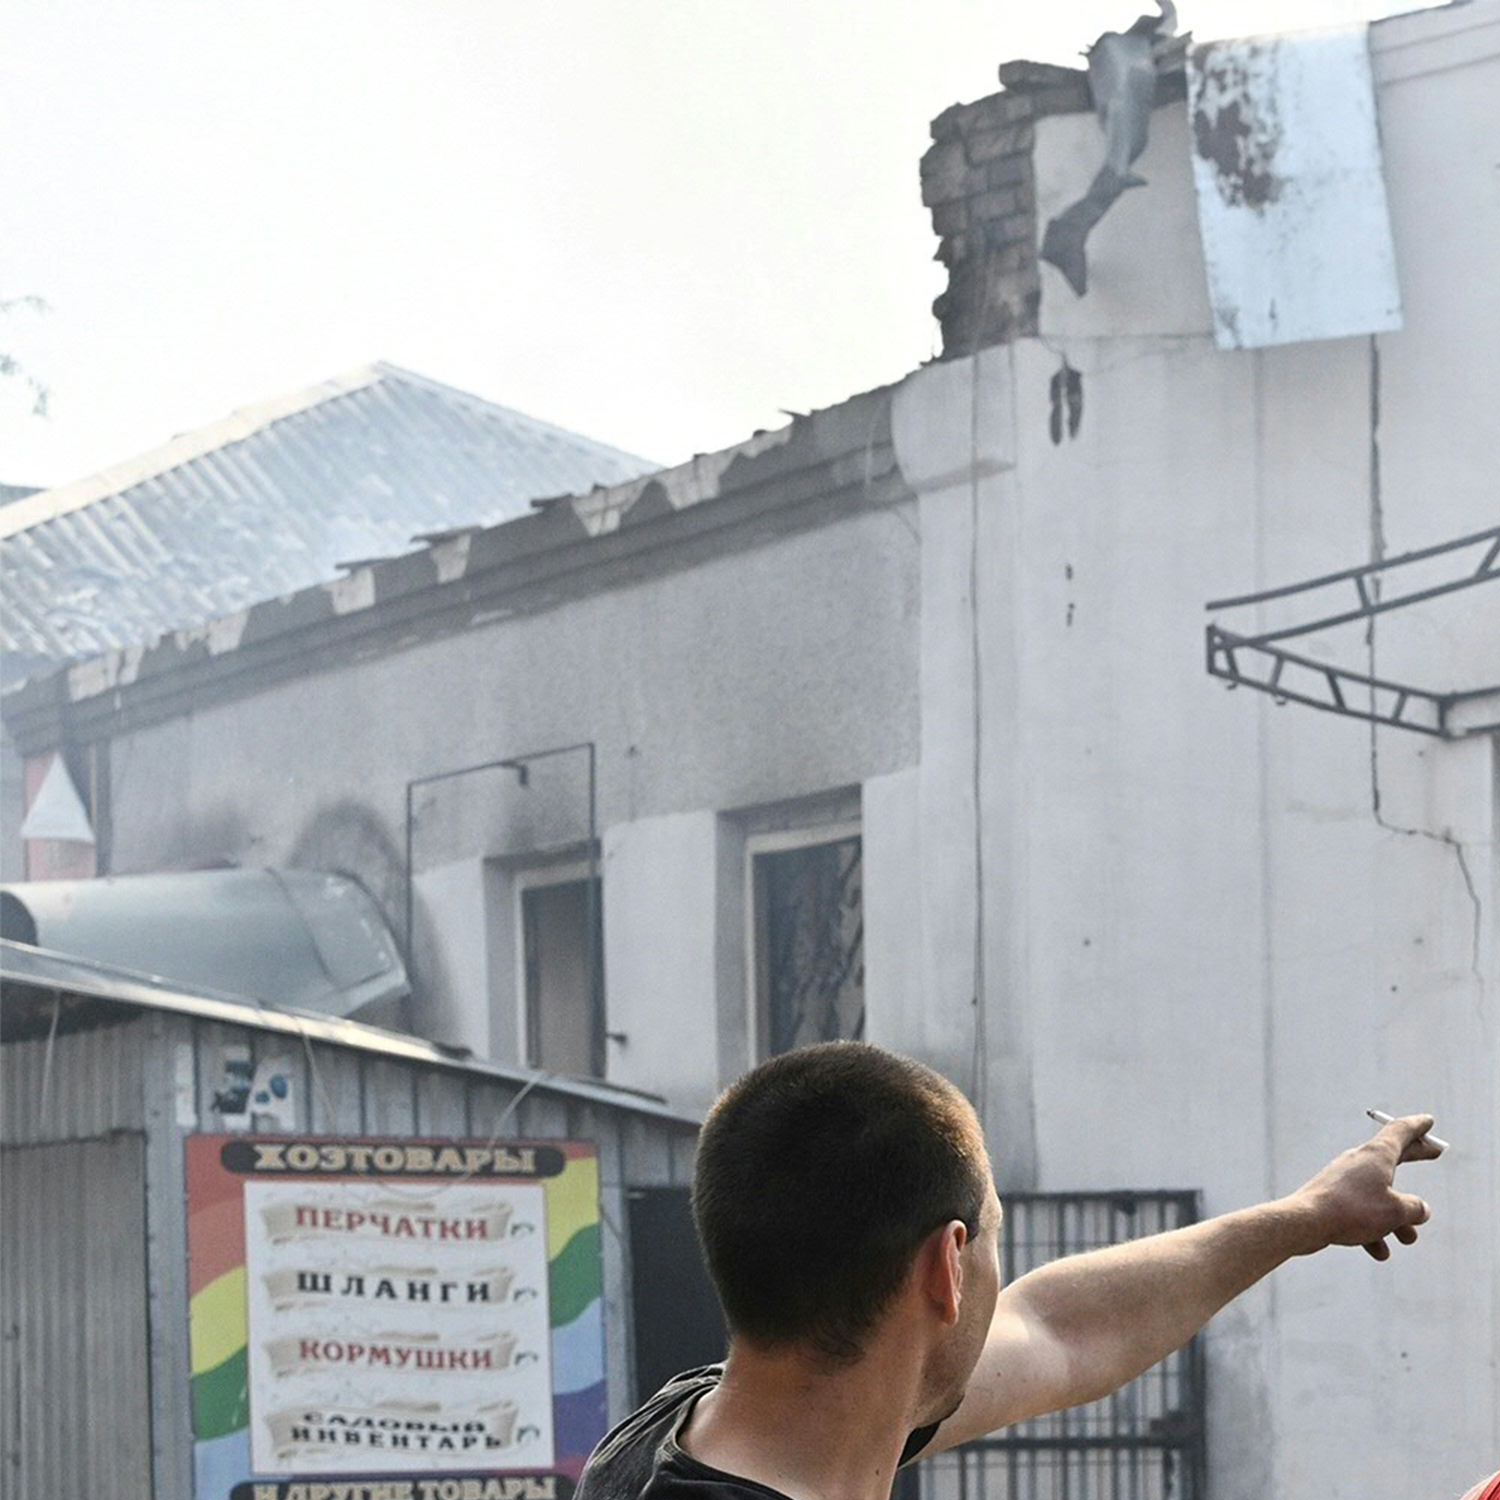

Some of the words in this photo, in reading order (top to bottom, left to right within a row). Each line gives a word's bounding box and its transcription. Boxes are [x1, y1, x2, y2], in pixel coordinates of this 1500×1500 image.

[253, 1144, 536, 1173] ХОЗТОВАРЫ
[294, 1205, 489, 1240] ПЕРЧАТКИ
[297, 1272, 491, 1303] ШЛАНГИ
[299, 1340, 493, 1370] КОРМУШКИ
[303, 1411, 487, 1433] САДОВЫЙ
[291, 1427, 503, 1450] ИНВЕНТАРЬ
